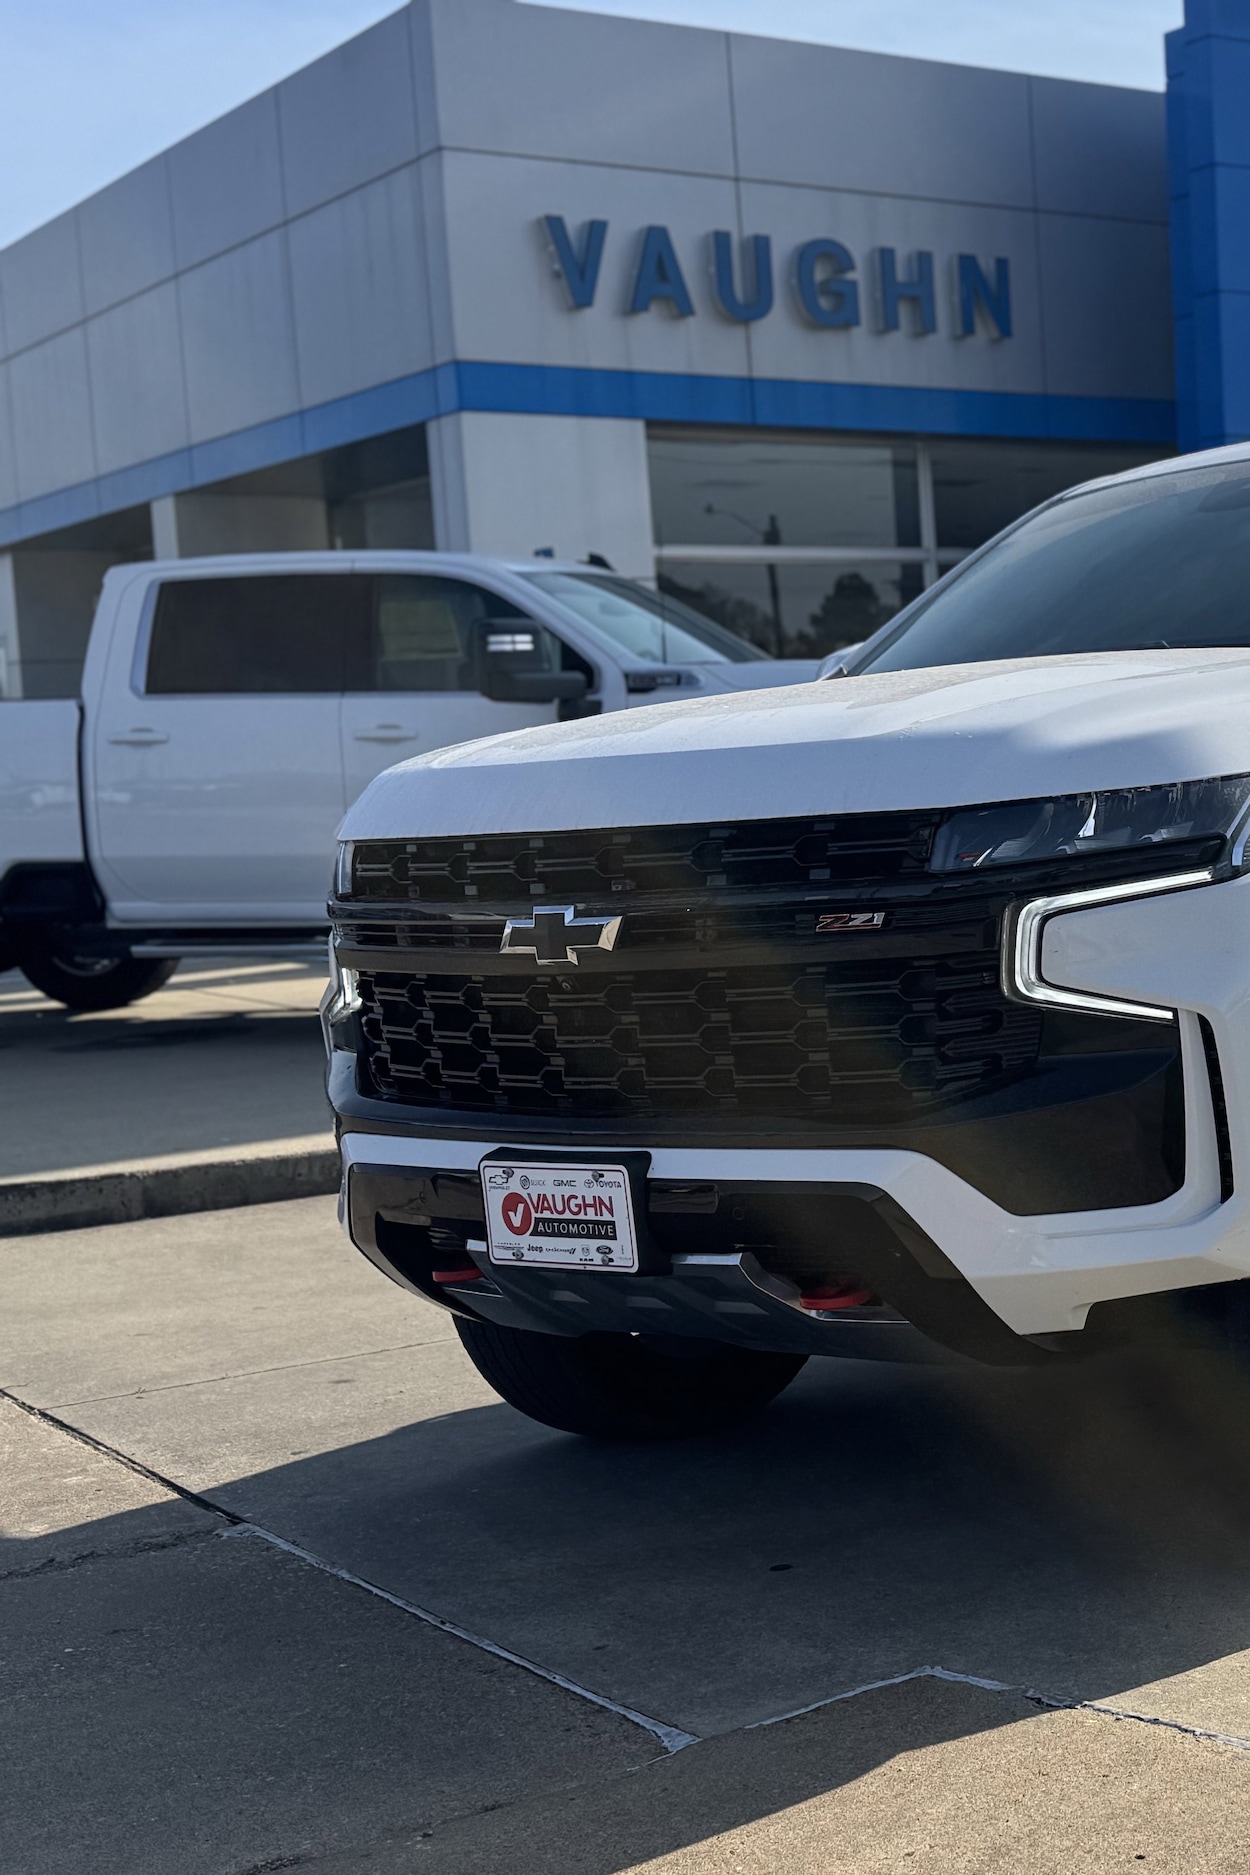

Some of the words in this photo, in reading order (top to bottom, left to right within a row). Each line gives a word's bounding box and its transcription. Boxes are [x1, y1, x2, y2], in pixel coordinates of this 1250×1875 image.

[541, 214, 1013, 340] VAUGHN
[816, 912, 886, 932] Z71
[553, 1179, 577, 1187] GMC
[596, 1180, 622, 1188] TOYOTA
[527, 1192, 615, 1218] VAUGHN
[537, 1222, 614, 1236] AUTOMOTIVE
[527, 1243, 543, 1253] Jeep
